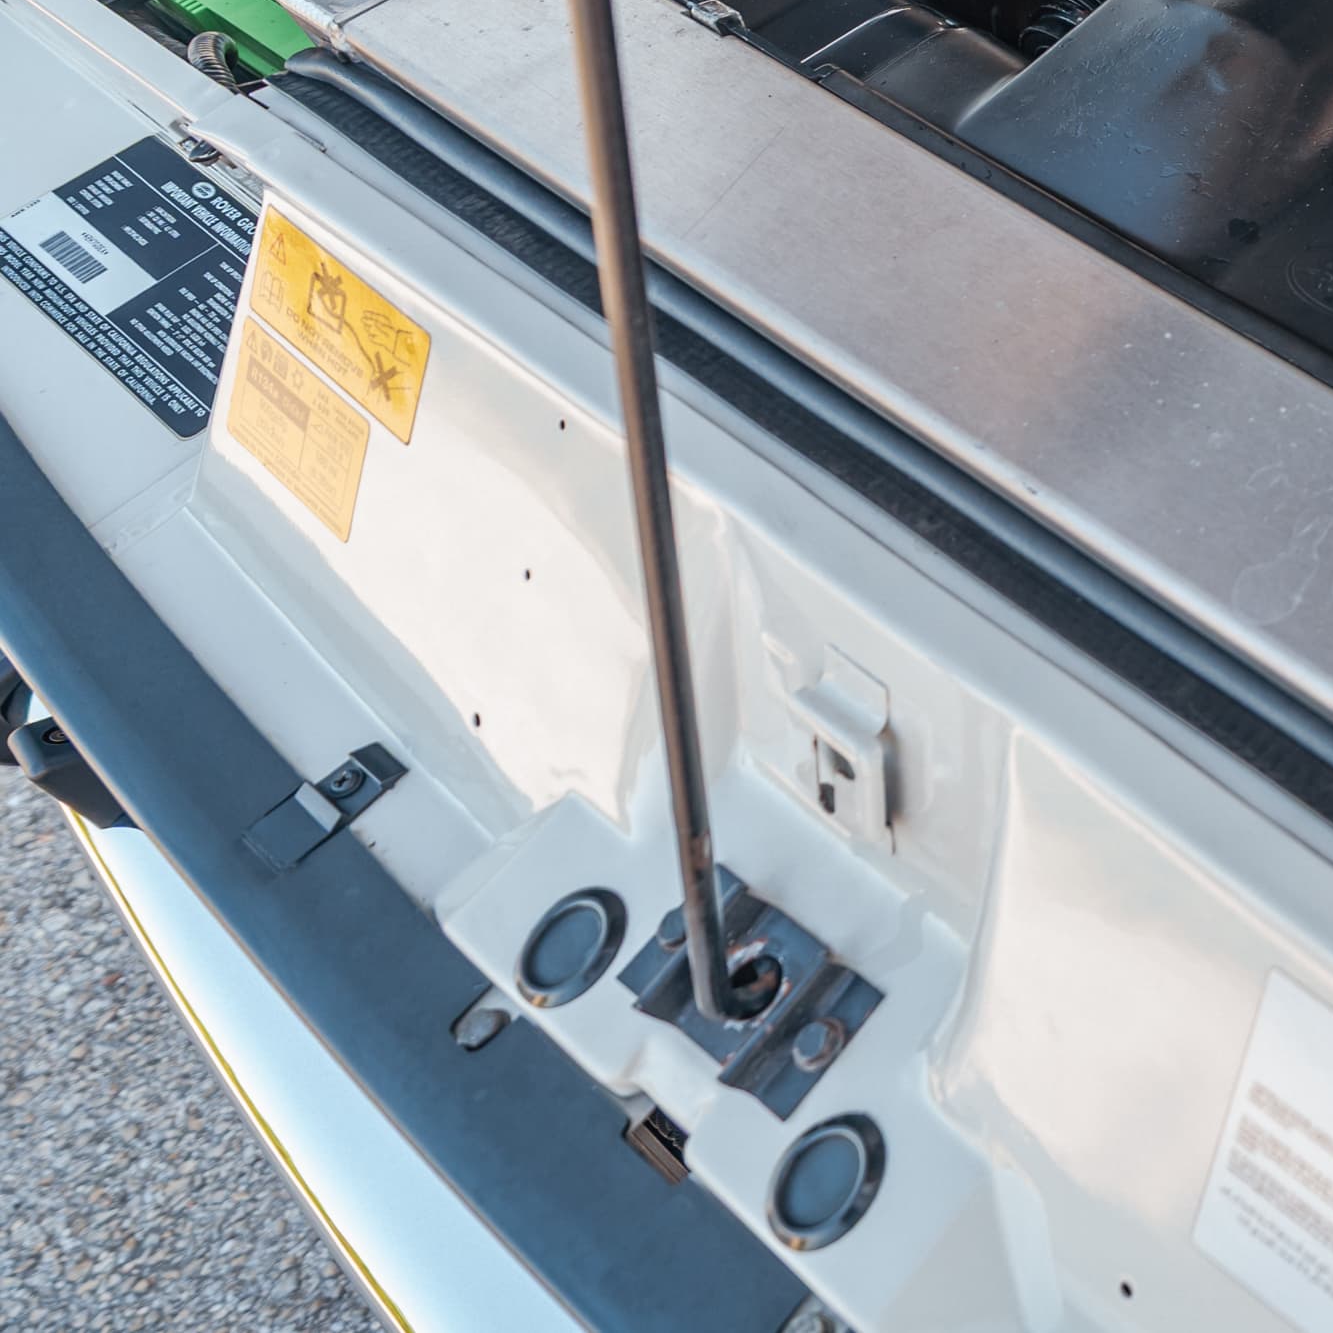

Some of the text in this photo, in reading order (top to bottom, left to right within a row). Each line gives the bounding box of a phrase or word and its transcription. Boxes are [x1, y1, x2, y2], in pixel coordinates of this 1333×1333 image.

[192, 202, 218, 230] VEHICLE
[211, 194, 257, 235] ROVER GRO
[107, 330, 138, 356] CALIFORNIA
[134, 353, 170, 385] REGULATIONS
[166, 382, 199, 412] APPLICABLE
[194, 407, 206, 417] TO
